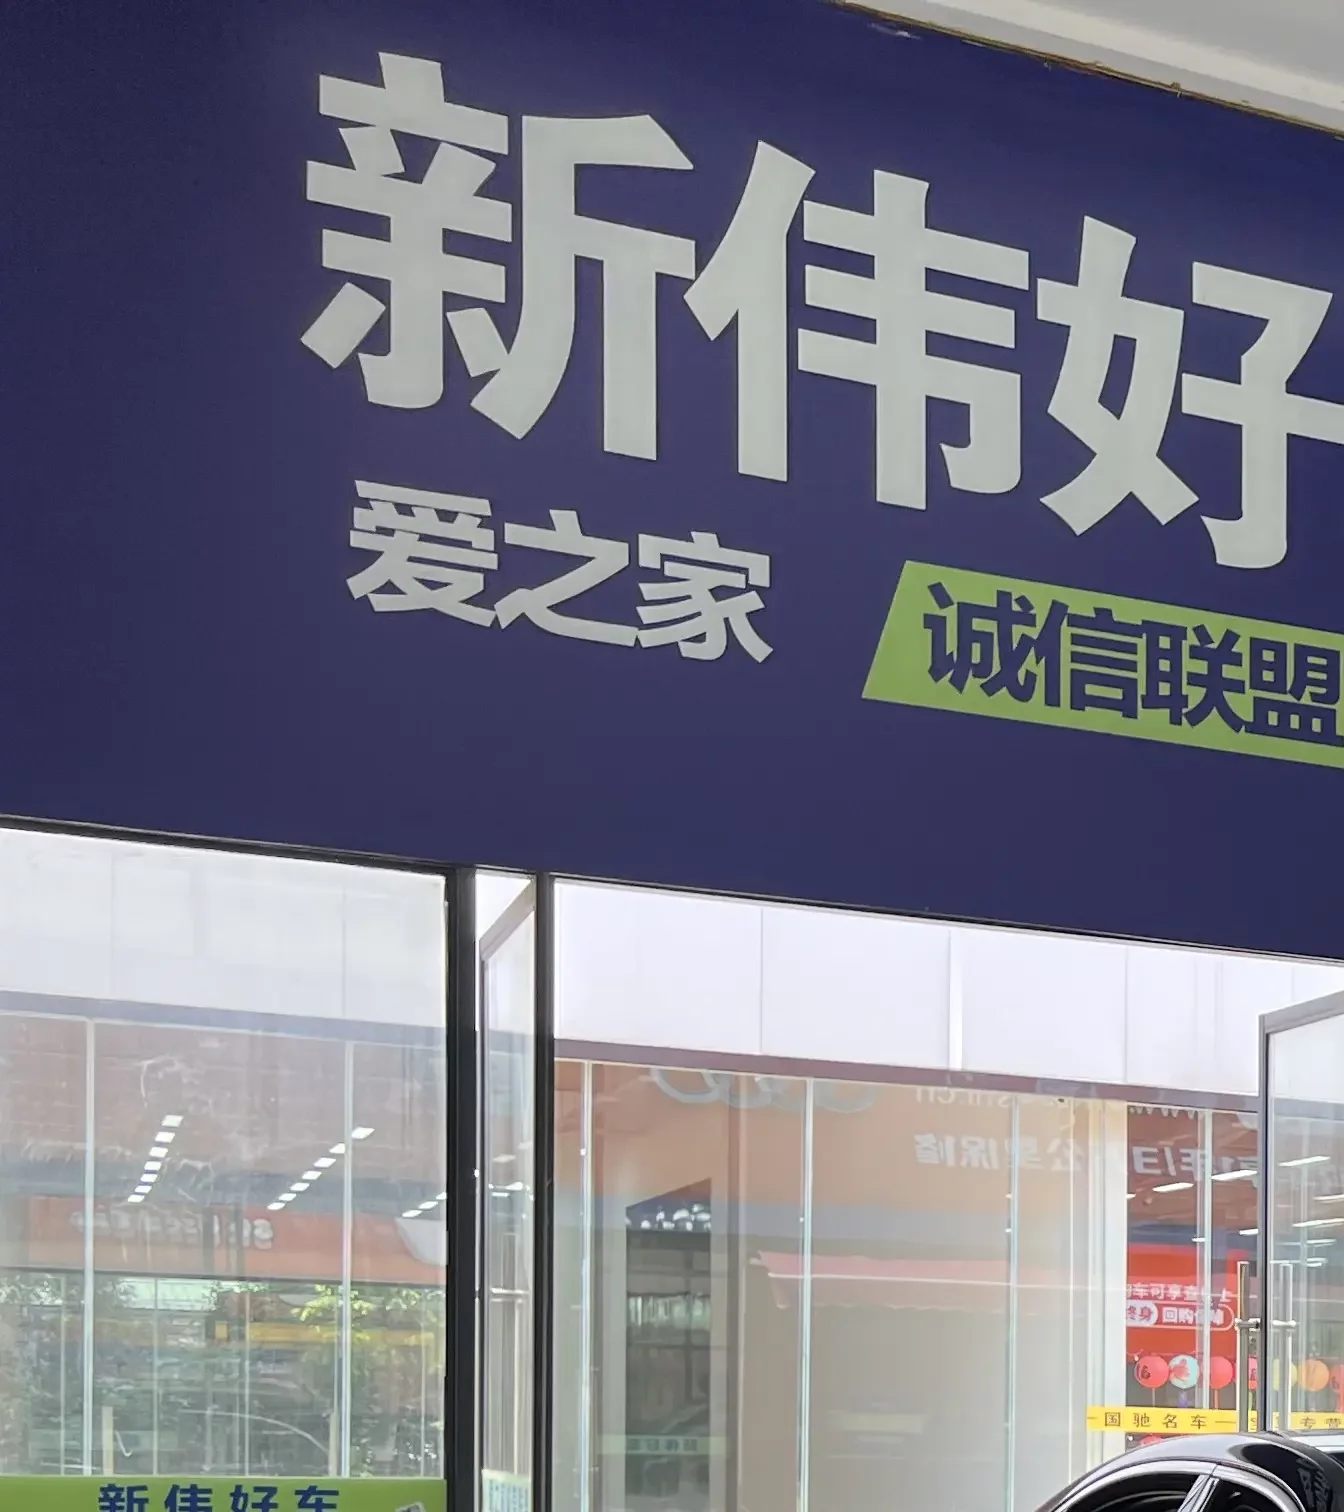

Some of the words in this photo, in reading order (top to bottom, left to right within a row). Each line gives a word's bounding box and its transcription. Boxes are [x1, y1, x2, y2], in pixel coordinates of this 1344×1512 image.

[347, 480, 770, 664] 爱之家
[1104, 1411, 1208, 1429] 国驰名车
